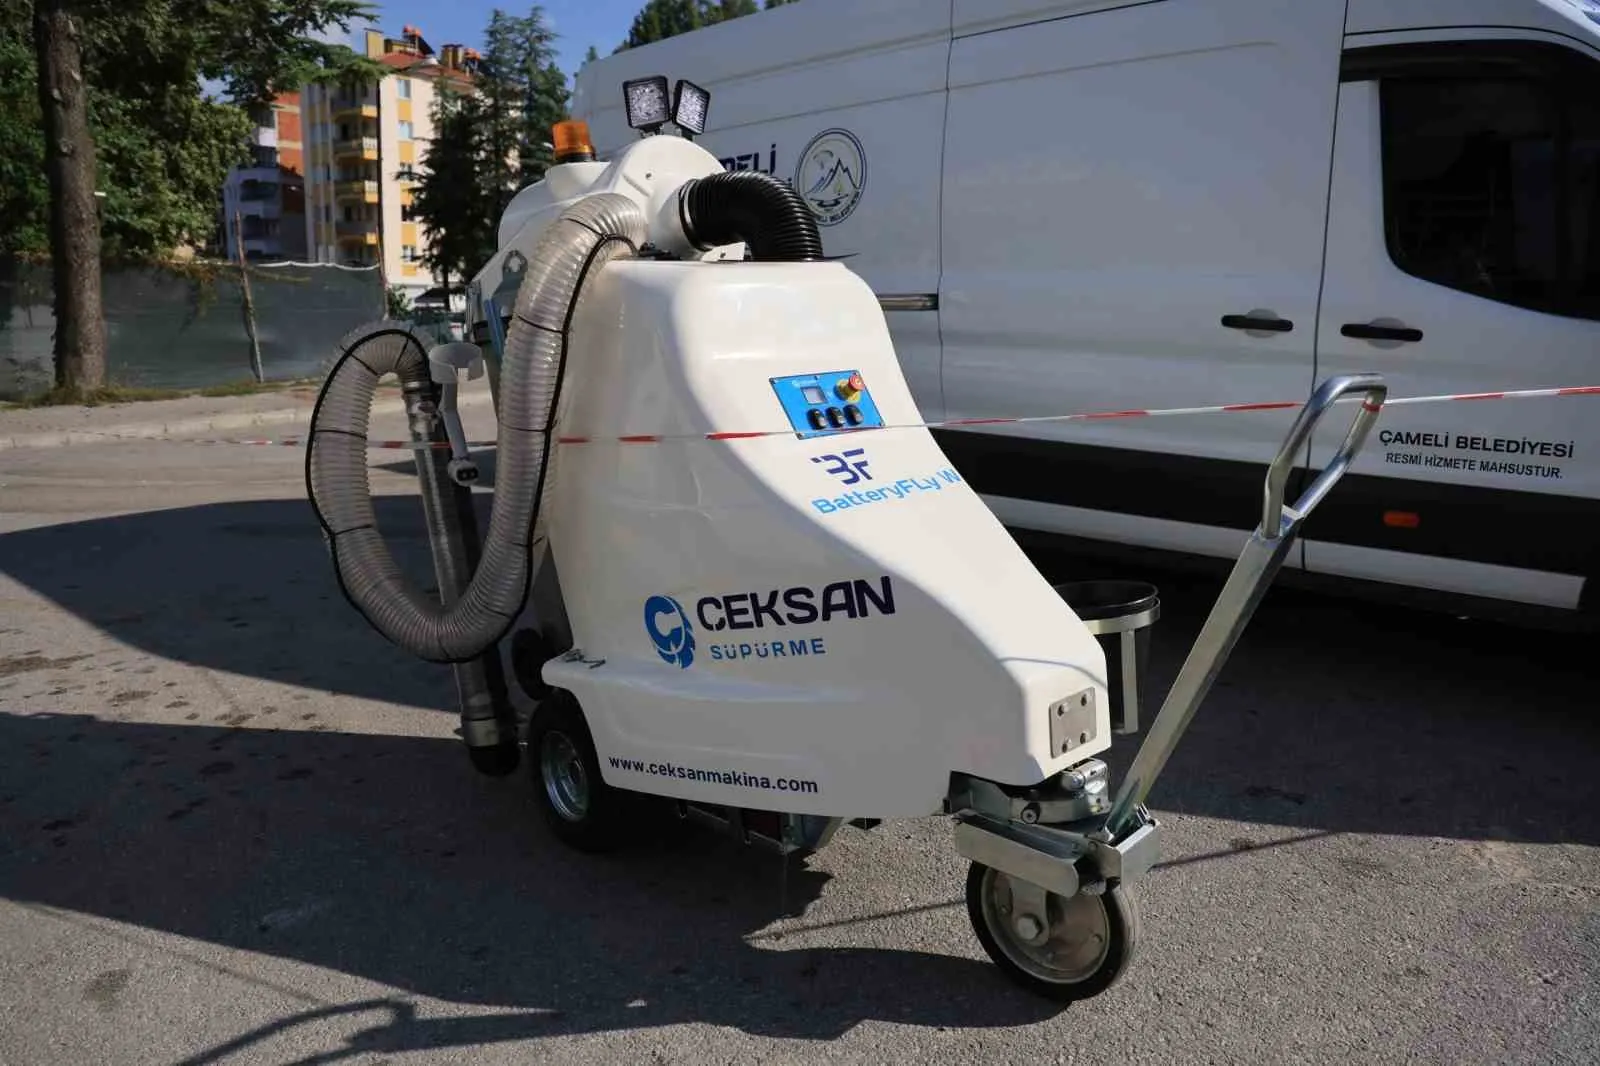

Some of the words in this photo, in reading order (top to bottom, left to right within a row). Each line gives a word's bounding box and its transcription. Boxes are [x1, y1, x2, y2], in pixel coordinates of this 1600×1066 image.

[1379, 430, 1449, 449] ÇAMELİ
[1456, 435, 1576, 458] BELEDİYESİ
[1386, 452, 1423, 465] RESMİ
[1424, 454, 1476, 471] HİZMETE
[1478, 460, 1563, 479] MAHSUSTUR.
[710, 637, 826, 660] SÜPÜRME
[608, 756, 819, 793] www.ceksanmakina.com
